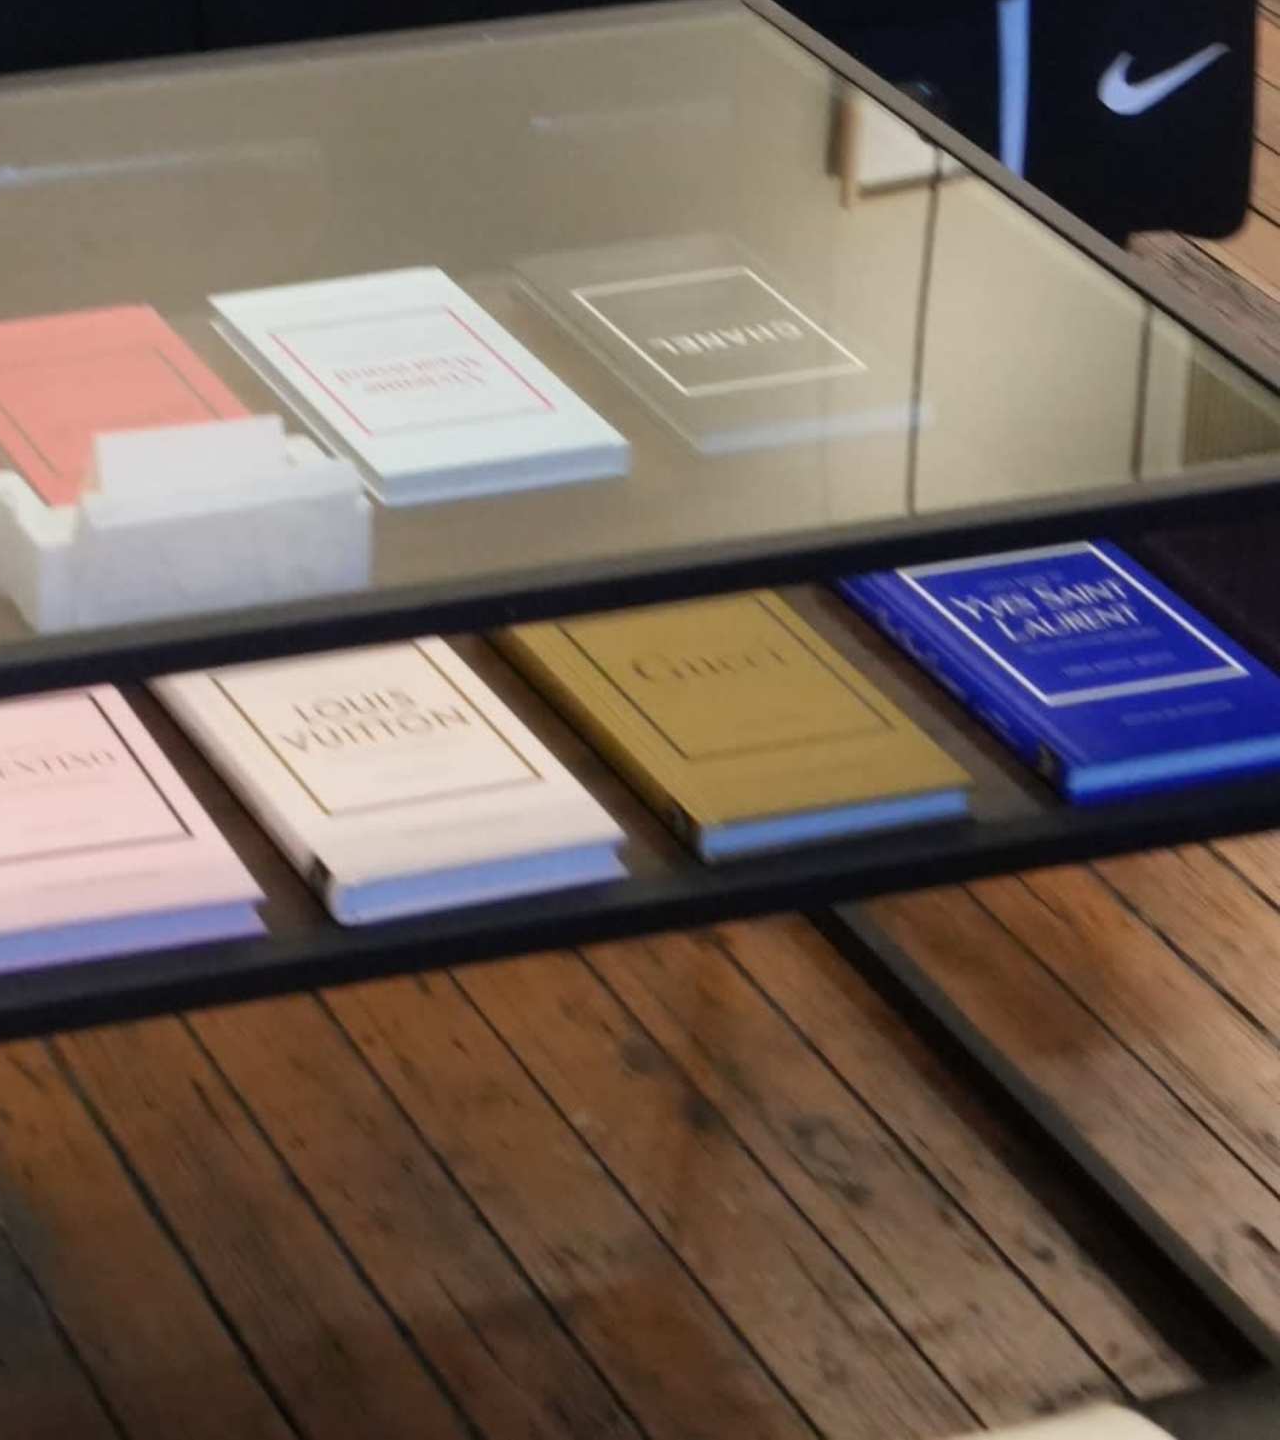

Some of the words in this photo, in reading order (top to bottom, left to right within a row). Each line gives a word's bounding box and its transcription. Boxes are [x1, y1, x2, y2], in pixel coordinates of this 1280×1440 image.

[647, 319, 805, 356] CHANEL
[948, 593, 1038, 622] YVES
[1031, 578, 1129, 608] SAINT
[992, 603, 1141, 643] LAURENT
[292, 686, 418, 724] LOUIS
[277, 704, 473, 753] VUITTON
